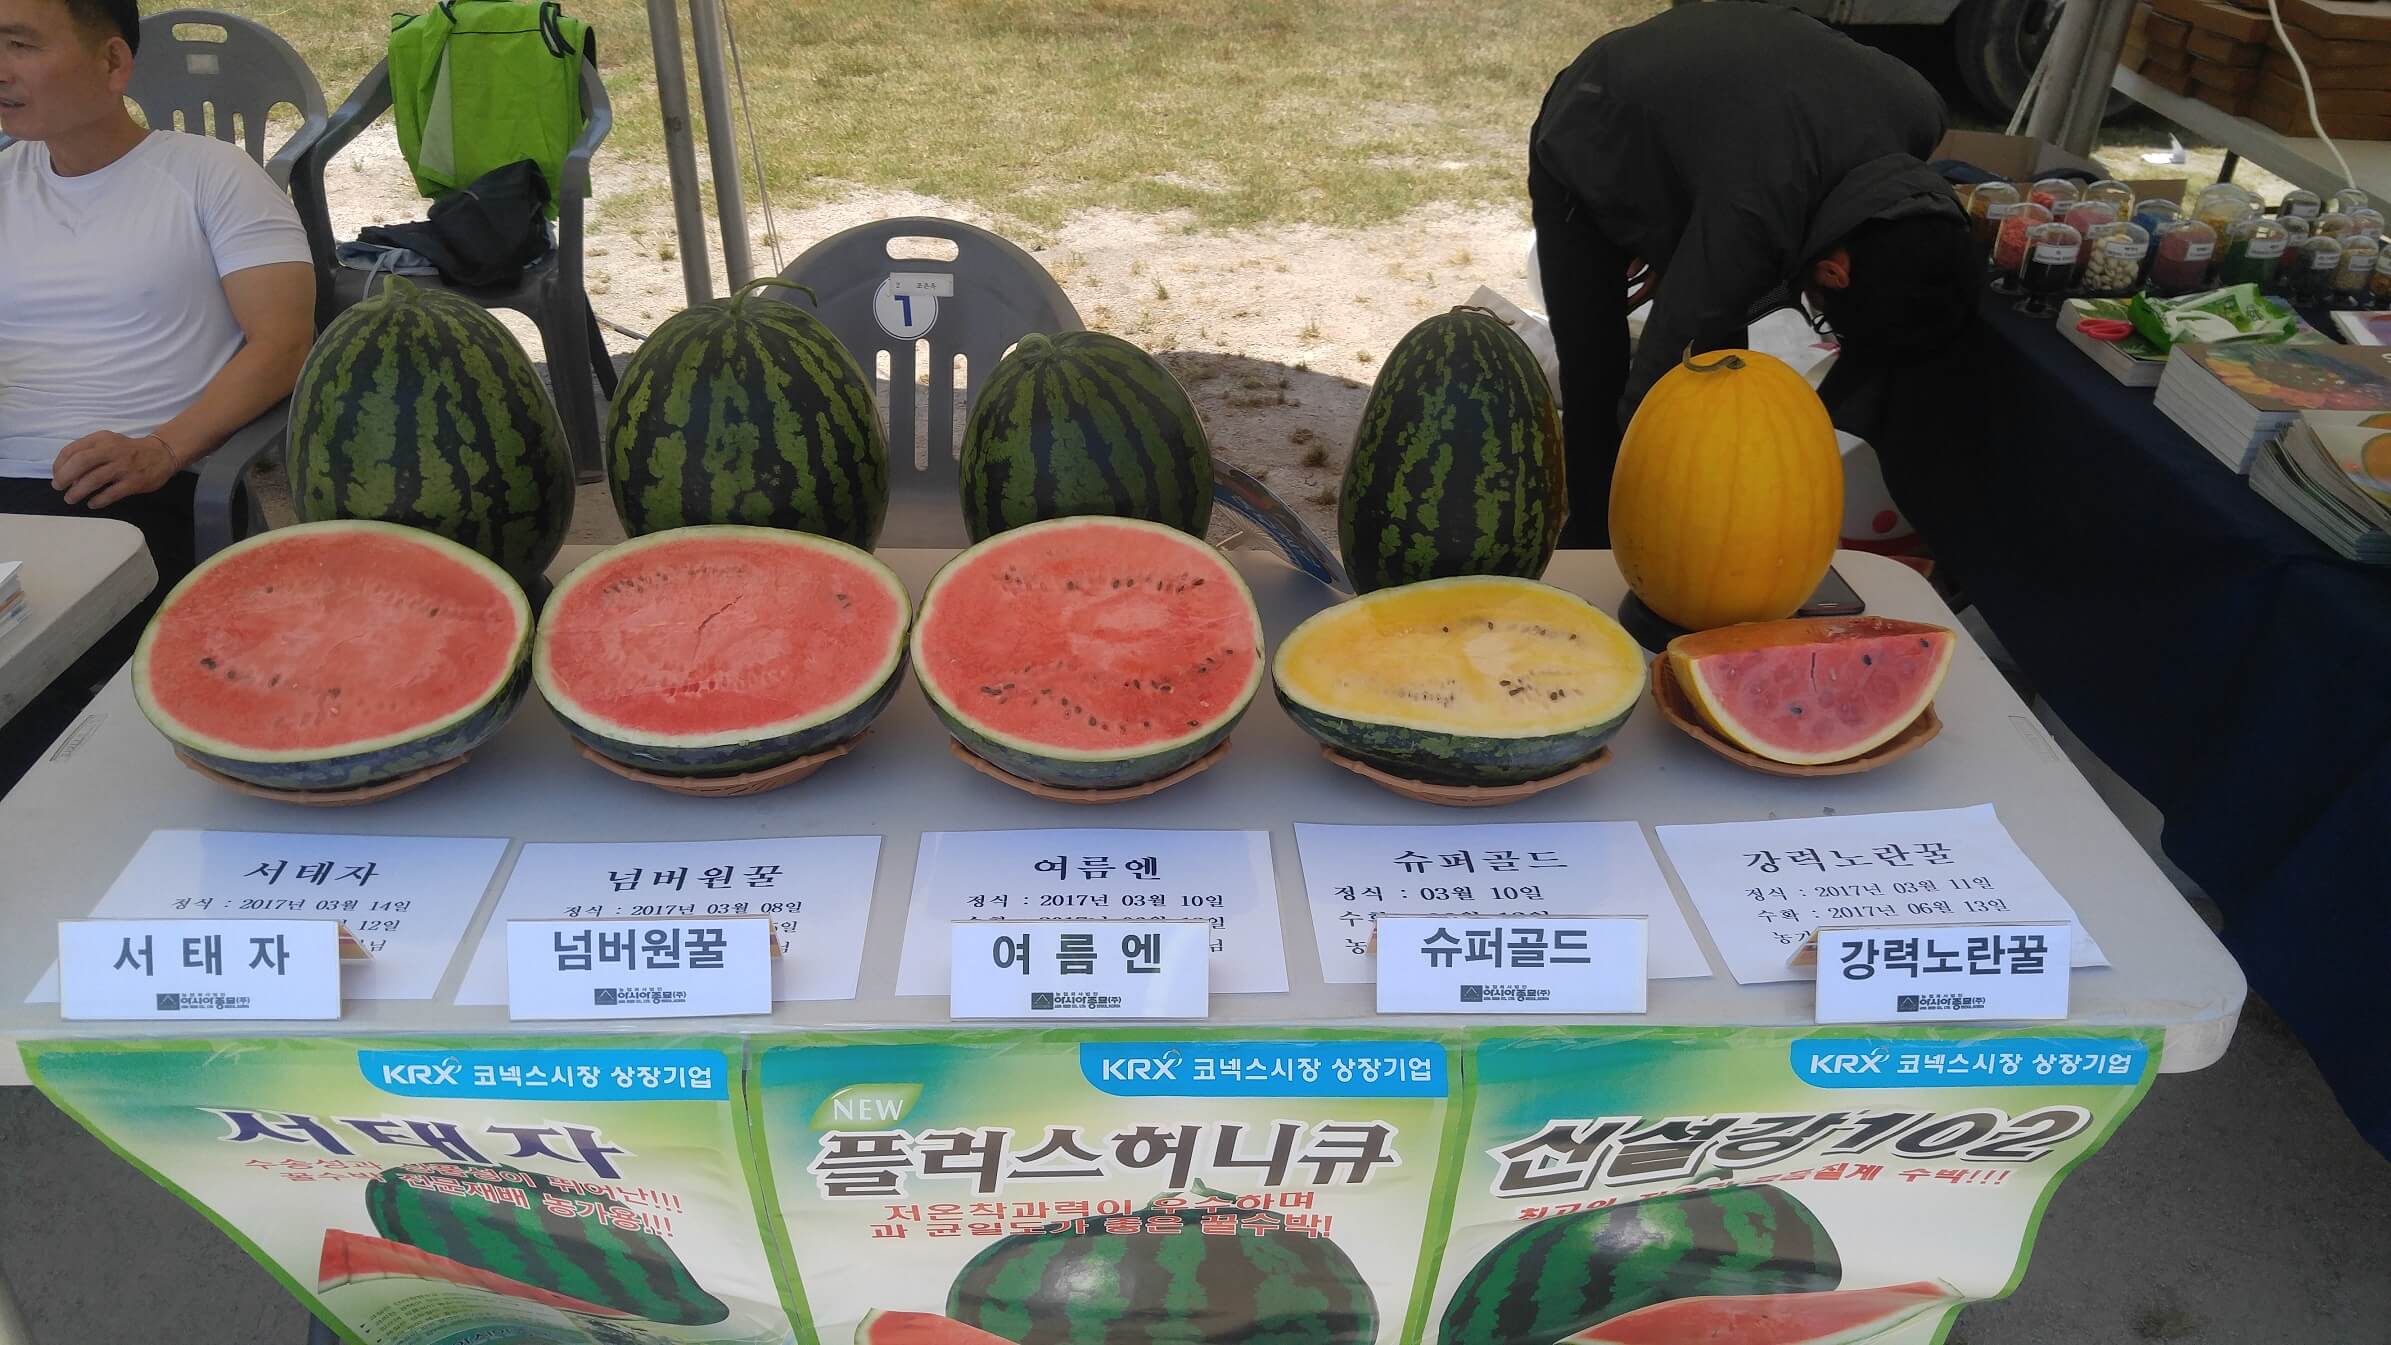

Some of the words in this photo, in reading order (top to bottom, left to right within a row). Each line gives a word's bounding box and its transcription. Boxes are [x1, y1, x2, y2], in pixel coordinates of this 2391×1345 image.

[1033, 854, 1162, 882] 여름엔
[1392, 848, 1569, 874] 슈퍼골드
[1741, 840, 1955, 873] 강력노란꿀
[243, 859, 382, 888] 서태자
[607, 864, 785, 892] 넘버원꿀
[965, 894, 1009, 908] 정식
[1039, 894, 1110, 908] 2017년
[1121, 894, 1168, 908] 03월
[1180, 894, 1226, 908] 10일
[1333, 885, 1384, 902] 정식
[1420, 885, 1476, 901] 03월
[1489, 885, 1545, 901] 10일
[1745, 886, 1789, 902] 정식
[1814, 882, 1885, 898] 2017년
[1892, 879, 1942, 894] 03월
[1948, 876, 1996, 891] 11일
[171, 897, 214, 911] 정식
[239, 898, 307, 911] 2017년
[315, 899, 360, 911] 03월
[368, 899, 412, 912] 14일
[563, 904, 604, 917] 정식
[630, 903, 696, 916] 2017년
[706, 902, 749, 915] 03월
[760, 900, 802, 914] 08일
[1757, 907, 1801, 923] 수확
[1827, 903, 1900, 919] 2017년
[1906, 899, 1956, 915] 06월
[1962, 898, 2013, 913] 13일
[357, 919, 401, 932] 12일
[113, 934, 291, 977] 서태자
[553, 927, 728, 971] 넘버원꿀
[991, 932, 1162, 976] 여름엔
[1420, 926, 1592, 969] 슈퍼골드
[1839, 933, 2049, 982] 강력노란꿀
[382, 1062, 460, 1086] KRX
[472, 1064, 601, 1088] 코넥스시장
[610, 1065, 713, 1089] 상장기업
[1102, 1055, 1180, 1081] KRX
[1192, 1056, 1322, 1083] 코넥스시장
[1331, 1056, 1433, 1083] 상장기업
[1810, 1052, 1886, 1075] KRX
[1896, 1053, 2024, 1075] 코넥스시장
[2031, 1053, 2133, 1075] 상장기업
[833, 1098, 904, 1121] NEW
[219, 1111, 628, 1180] 서태자
[814, 1121, 1396, 1197] 플러스허니큐
[1898, 1167, 2012, 1185] 수박!!!
[396, 1172, 531, 1210] 전문재배
[541, 1191, 674, 1238] 농가용!!!
[546, 1175, 683, 1214] 뛰어난!!!
[884, 1199, 1132, 1222] 저온착과력이
[1150, 1191, 1315, 1215] 우수하며
[869, 1223, 908, 1239] 과
[926, 1218, 1089, 1238] 균일도가
[1103, 1215, 1184, 1235] 좋은
[1200, 1213, 1334, 1239] 꿀수박!
